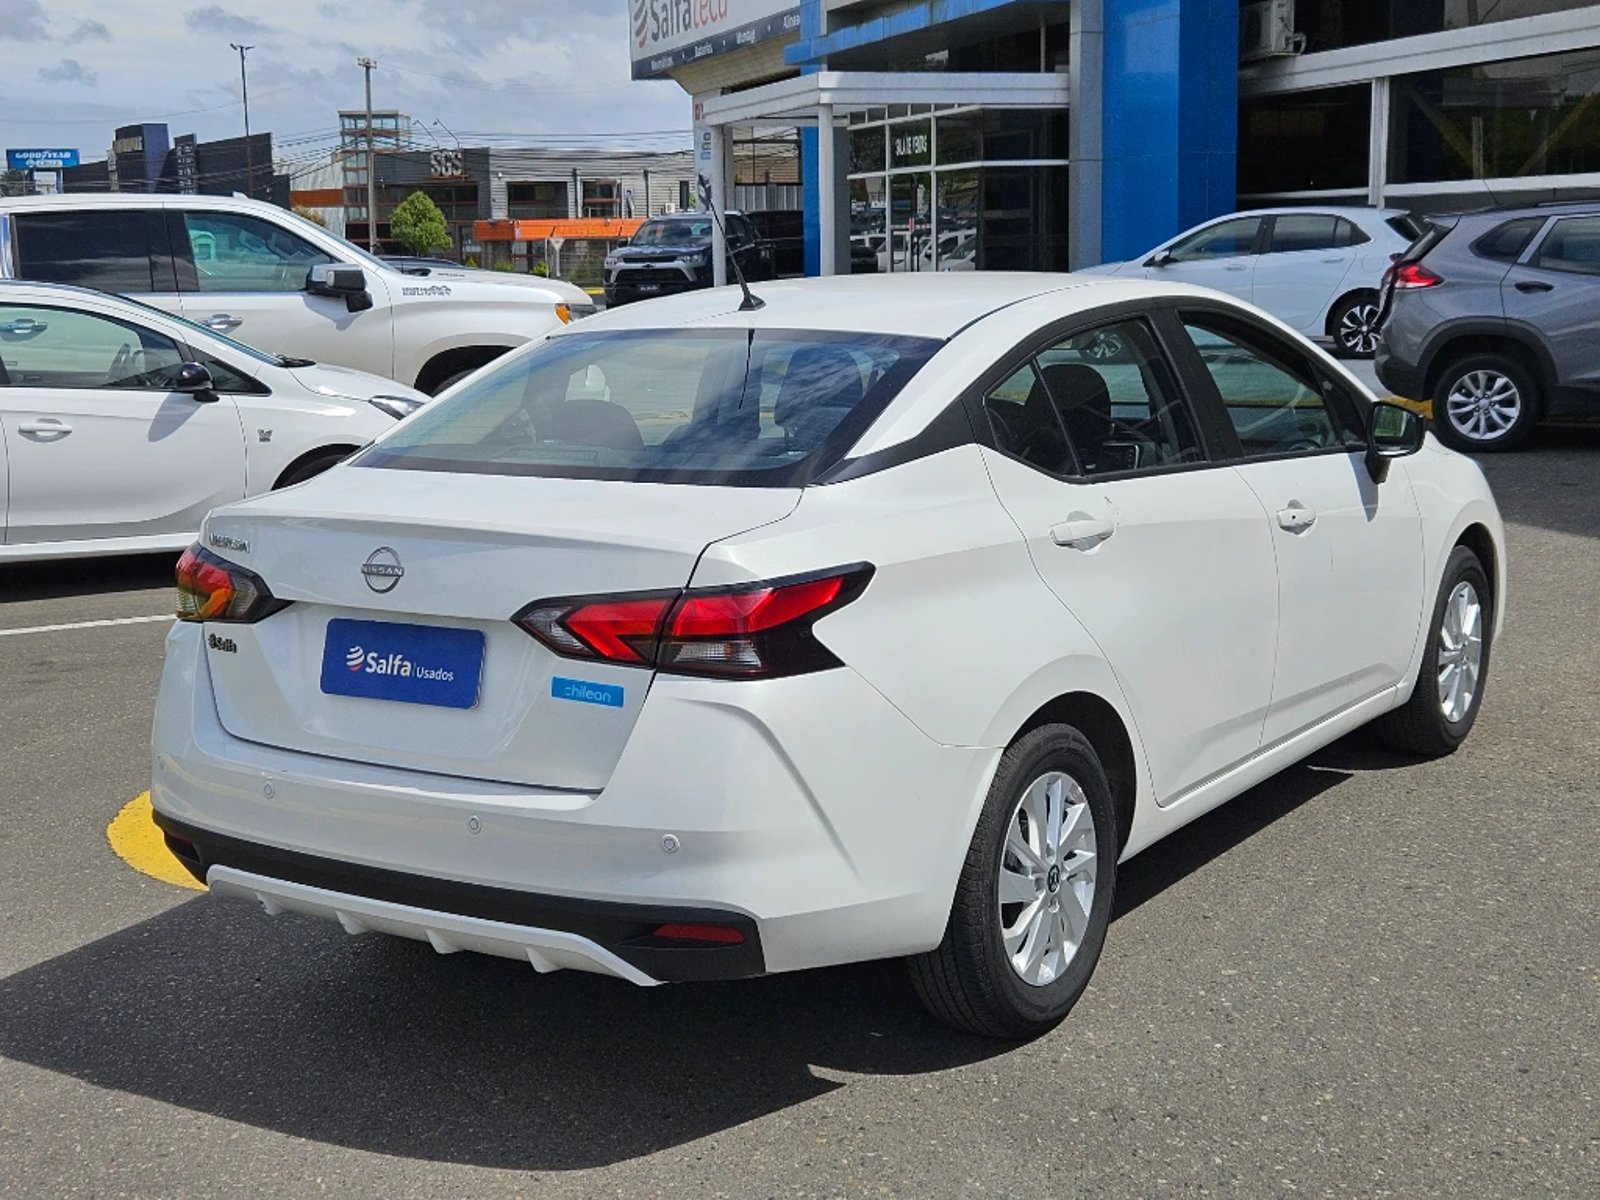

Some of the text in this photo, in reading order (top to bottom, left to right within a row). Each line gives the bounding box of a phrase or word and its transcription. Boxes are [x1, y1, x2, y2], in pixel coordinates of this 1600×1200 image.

[15, 151, 71, 159] GOODYEAR
[430, 151, 462, 175] SGS
[362, 565, 403, 576] NISSAN
[365, 652, 454, 682] Salfa Usados
[564, 685, 612, 702] chilean
